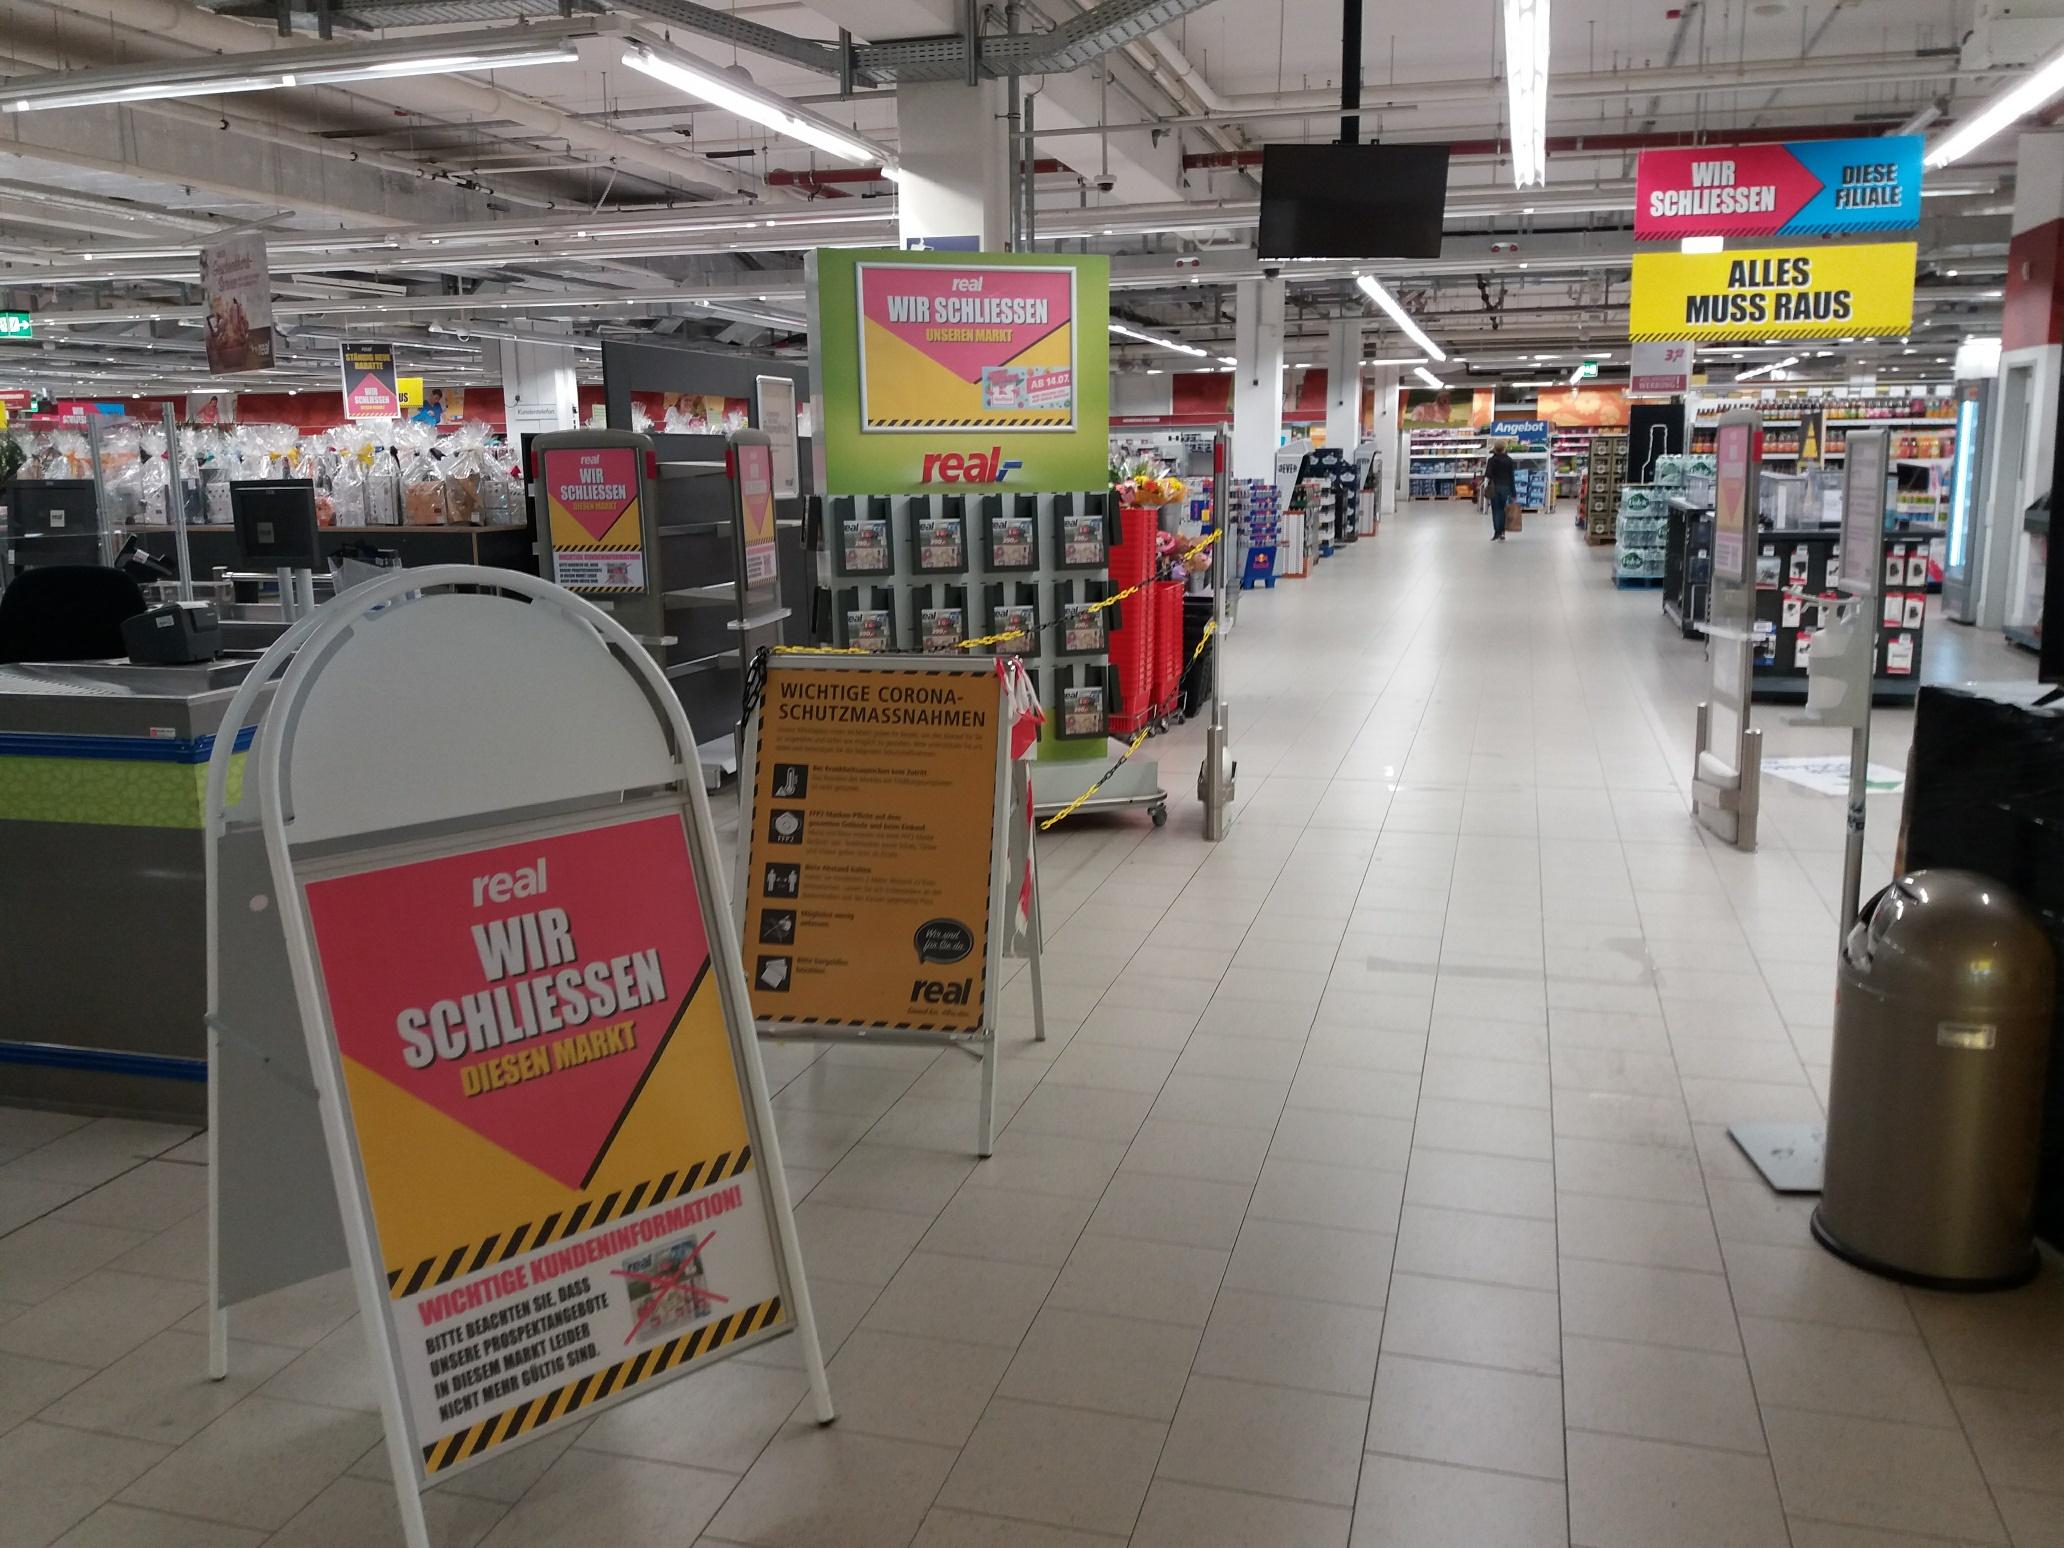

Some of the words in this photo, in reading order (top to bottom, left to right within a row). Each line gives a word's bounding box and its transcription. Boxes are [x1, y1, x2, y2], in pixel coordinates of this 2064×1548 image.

[1692, 161, 1736, 187] WIR
[1842, 163, 1898, 186] DIESE
[1650, 186, 1776, 217] SCHLIESSEN
[1835, 186, 1902, 208] FILIALE
[952, 275, 984, 292] real
[1728, 257, 1812, 289] ALLES
[887, 296, 930, 323] WIR
[935, 297, 1048, 324] SCHLIESSEN
[1686, 293, 1767, 325] MUSS
[1773, 290, 1853, 322] RAUS
[926, 328, 973, 343] UNSEREN
[975, 328, 1013, 343] MARKT
[1495, 421, 1544, 434] Angebot
[580, 455, 600, 464] real
[579, 468, 604, 484] WIR
[560, 485, 626, 500] SCHLIESSEN
[844, 523, 859, 532] eal
[920, 522, 934, 531] eal
[992, 521, 1007, 529] eal
[1064, 519, 1078, 527] eal
[848, 614, 863, 623] eal
[922, 612, 937, 620] eal
[781, 682, 870, 703] WICHTIGE
[878, 686, 964, 705] CORONA-
[1065, 691, 1079, 699] eal
[778, 703, 986, 727] SCHUTZMASSNAHMEN
[777, 835, 794, 843] FFP2
[472, 857, 547, 907] real
[471, 907, 577, 983] WIR
[910, 978, 973, 1005] real
[396, 948, 667, 1069] SCHLIESSEN
[460, 1046, 552, 1098] DIESEN
[552, 1020, 636, 1070] MARKT
[417, 1259, 530, 1327] WICHTIGE
[530, 1184, 743, 1283] KUNDENINFORMATION!
[425, 1327, 465, 1355] BITTE
[466, 1302, 532, 1342] BEACHTEN
[559, 1276, 592, 1303] DASS
[430, 1344, 481, 1378] UNSERE
[482, 1292, 609, 1357] PROSPEKTANGEBOTE
[434, 1379, 450, 1398] IN
[451, 1360, 501, 1393] DIESEM
[503, 1343, 548, 1372] MARKT
[549, 1322, 592, 1356] LEIDER
[439, 1394, 481, 1424] NICHT
[481, 1377, 521, 1406] MEHR
[521, 1355, 565, 1388] GÜLTIG
[565, 1342, 600, 1371] SIND.
